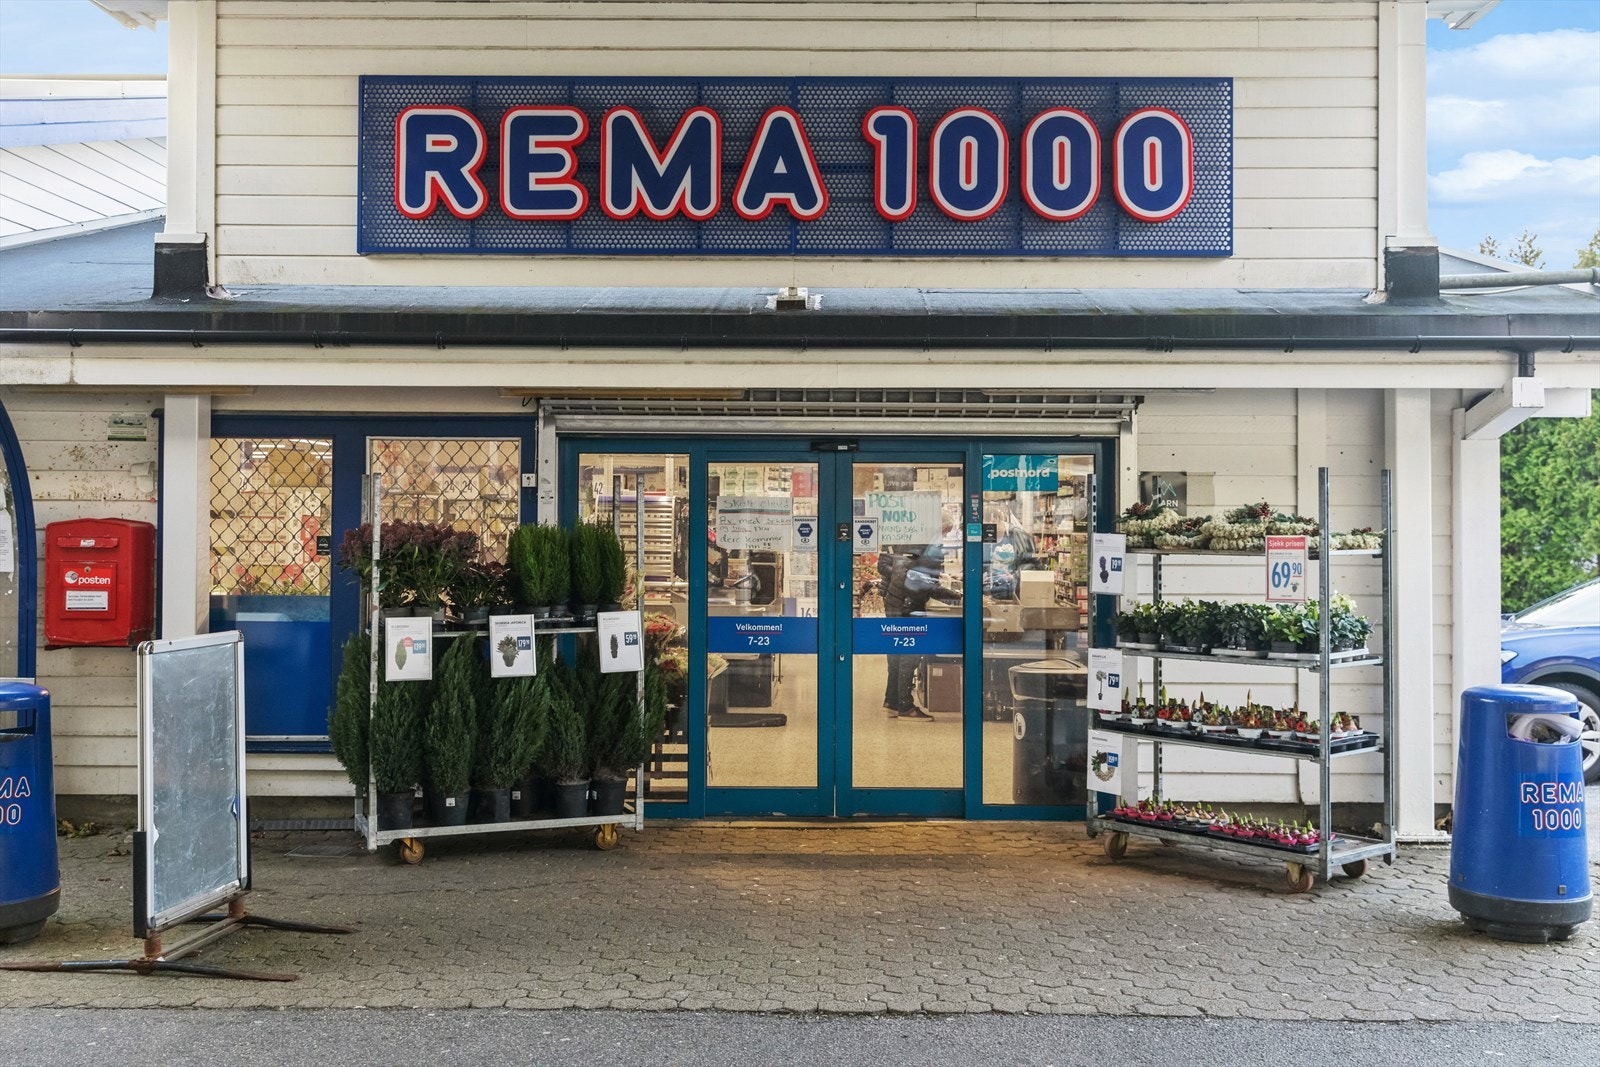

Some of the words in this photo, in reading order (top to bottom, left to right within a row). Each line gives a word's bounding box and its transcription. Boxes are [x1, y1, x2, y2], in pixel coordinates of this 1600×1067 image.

[395, 105, 829, 222] REMA
[863, 105, 1193, 222] 1000
[991, 468, 1050, 479] postnord
[868, 493, 904, 508] POST
[882, 510, 917, 522] NORD
[1269, 540, 1284, 548] Sjekk
[78, 576, 111, 586] posten
[736, 623, 783, 631] Velkommen!
[881, 624, 928, 632] Velkommen!
[748, 636, 770, 646] 7-23
[893, 637, 916, 647] 7-23
[1521, 782, 1584, 804] REMA
[1532, 808, 1582, 831] 1000
